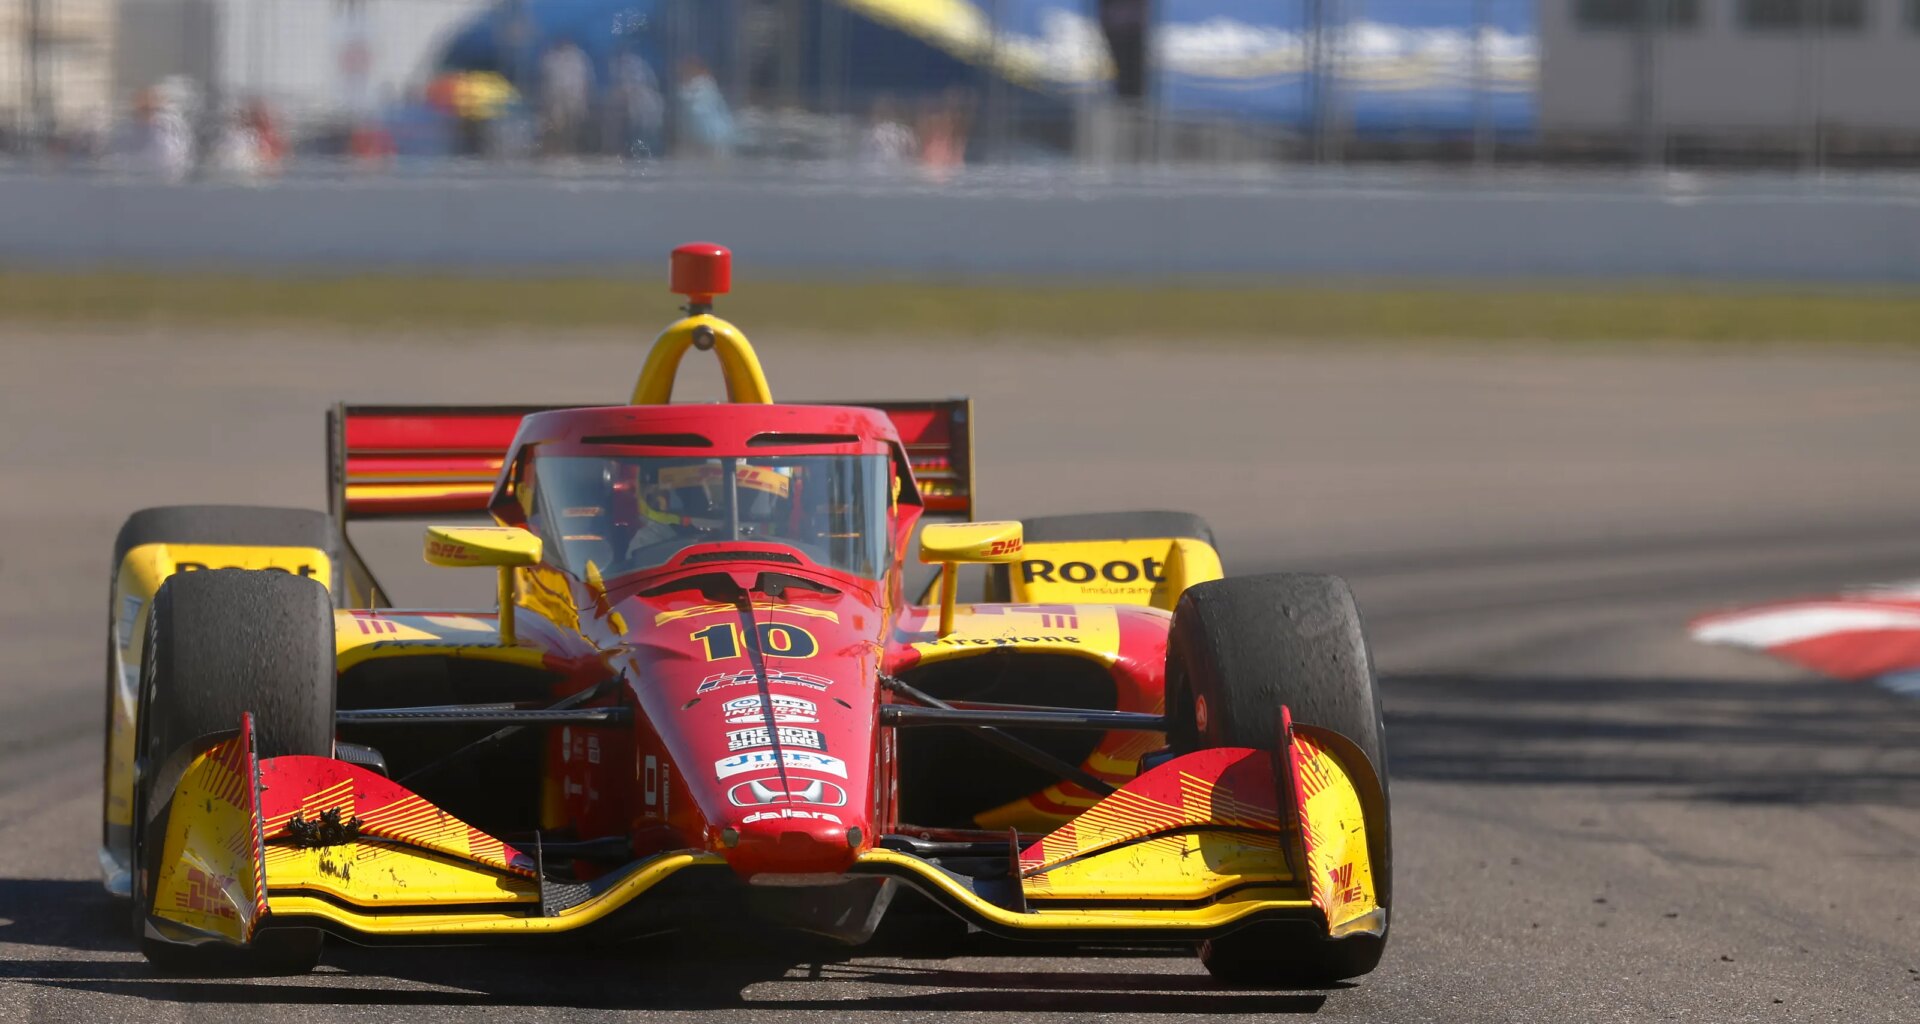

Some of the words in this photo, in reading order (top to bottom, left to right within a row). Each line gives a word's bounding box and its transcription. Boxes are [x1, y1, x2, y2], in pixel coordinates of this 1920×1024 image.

[431, 541, 468, 560] DHL
[990, 538, 1022, 556] DHL
[1022, 556, 1167, 584] Root
[690, 622, 819, 662] 10
[725, 707, 816, 716] INDCAR
[725, 753, 838, 767] JIFFY
[742, 808, 843, 825] dallara
